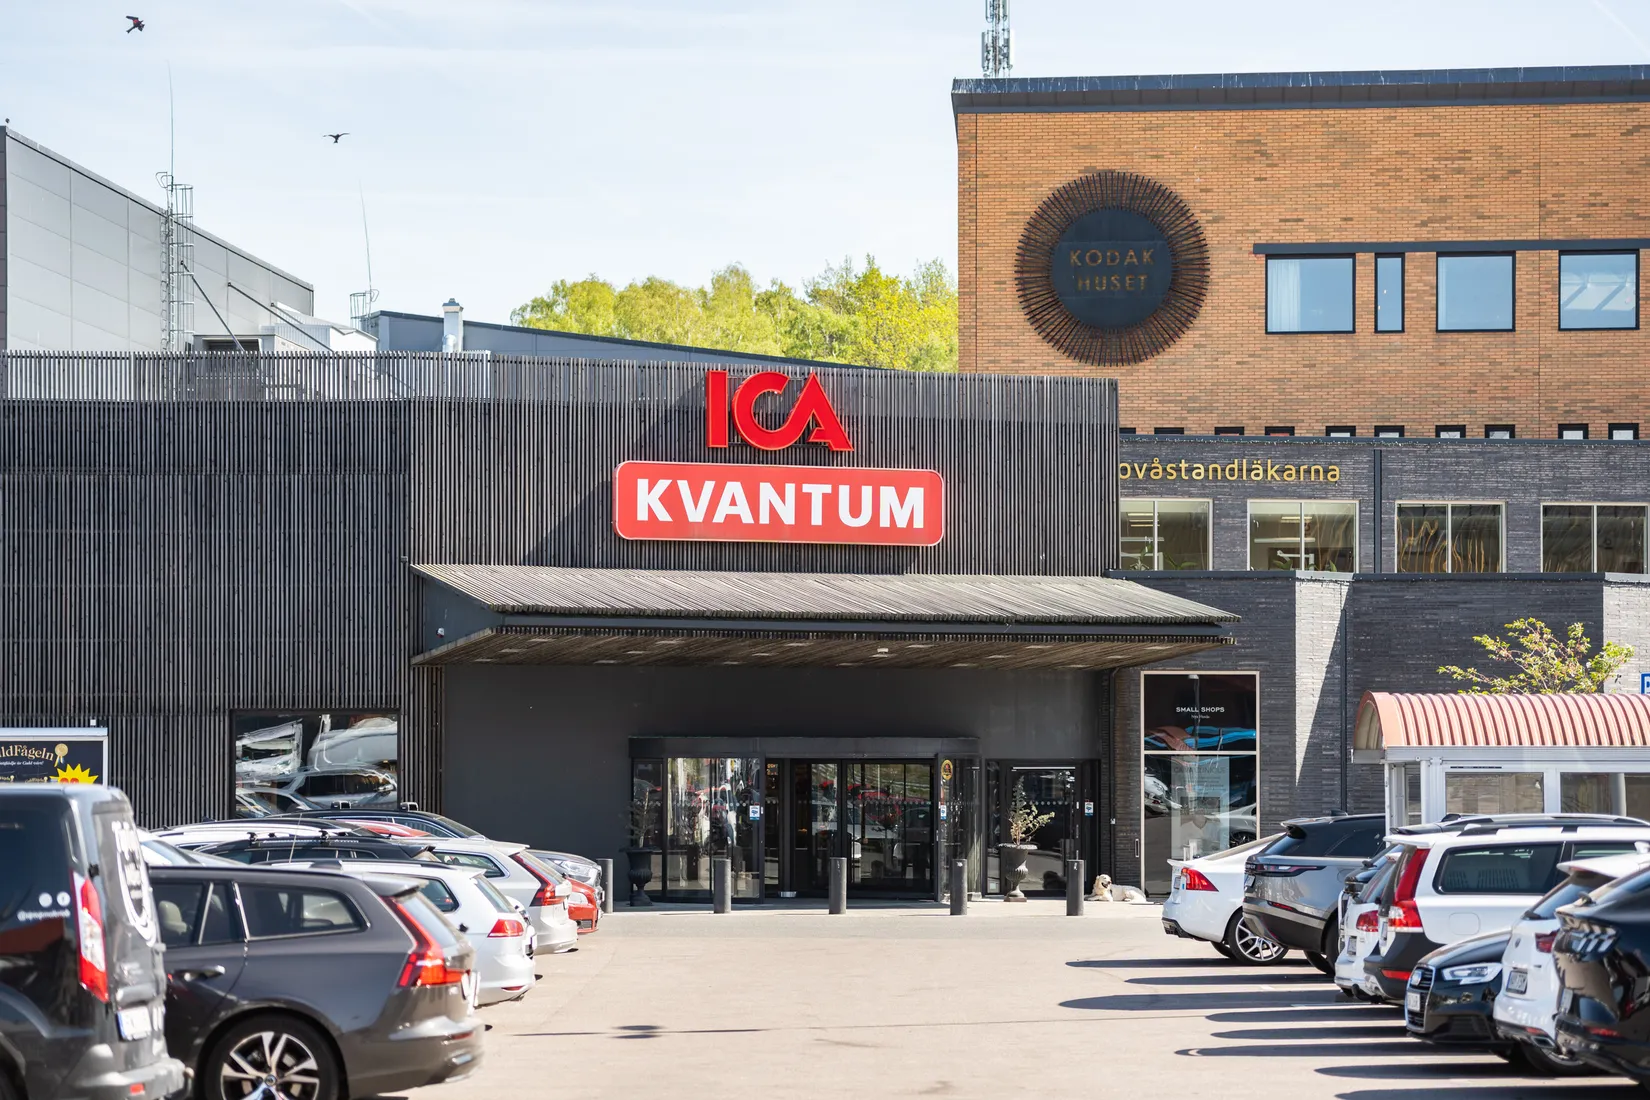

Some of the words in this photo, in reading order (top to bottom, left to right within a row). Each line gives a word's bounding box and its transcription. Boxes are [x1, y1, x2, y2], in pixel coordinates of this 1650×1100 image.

[1069, 249, 1154, 266] KODAK
[1078, 275, 1148, 291] HUSET
[706, 370, 854, 451] ICA
[636, 478, 925, 529] KVANTUM
[0, 744, 54, 761] ldFågeln
